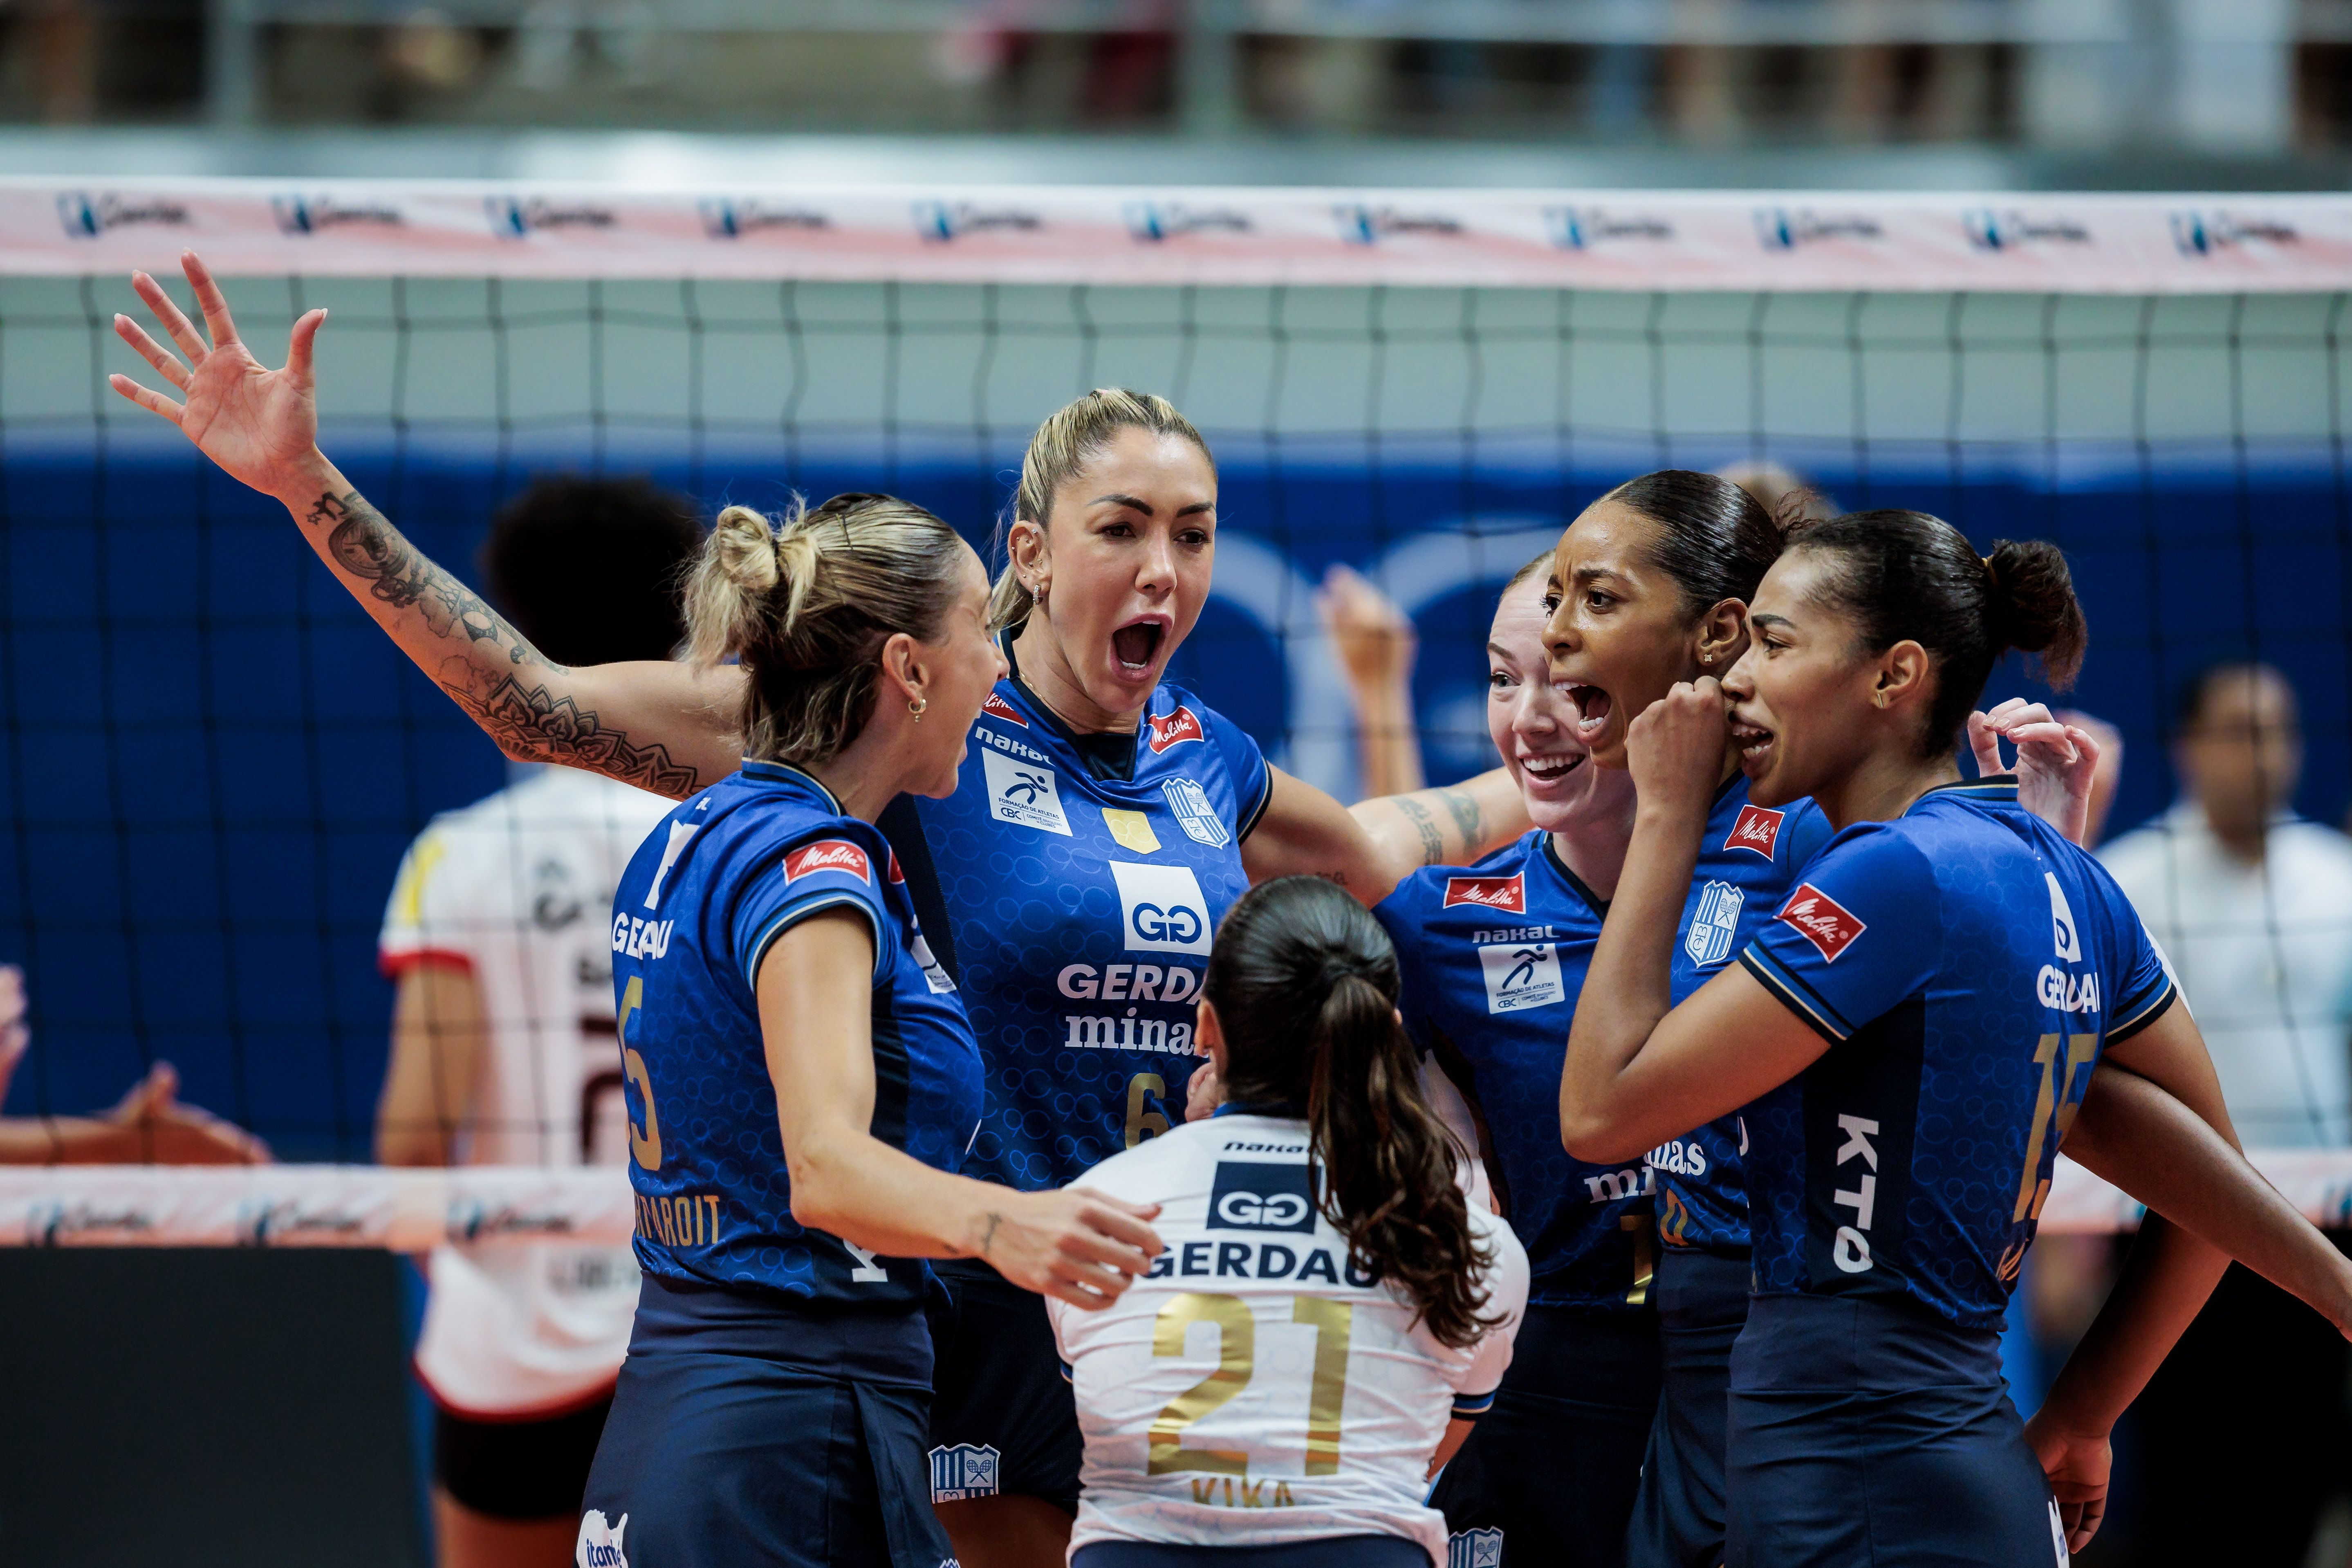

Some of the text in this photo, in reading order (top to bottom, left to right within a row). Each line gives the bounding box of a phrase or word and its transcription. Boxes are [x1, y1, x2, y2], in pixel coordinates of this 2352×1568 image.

[1152, 719, 1193, 745] Melitta
[998, 797, 1029, 810] FORMAÇÃO
[1038, 809, 1059, 819] ATLETAS
[1001, 807, 1022, 820] CBC
[1734, 813, 1770, 843] Melitta
[794, 846, 860, 875] Melitta
[1453, 884, 1515, 905] Melitta
[1786, 898, 1839, 943] Melitta
[1057, 964, 1206, 1005] GERD
[2036, 964, 2100, 1014] GERDA
[1498, 998, 1517, 1008] CBC
[1065, 1007, 1209, 1059] mina
[1224, 1141, 1310, 1153] naka
[1834, 1113, 1879, 1273] KTO
[1147, 1292, 1353, 1476] 21
